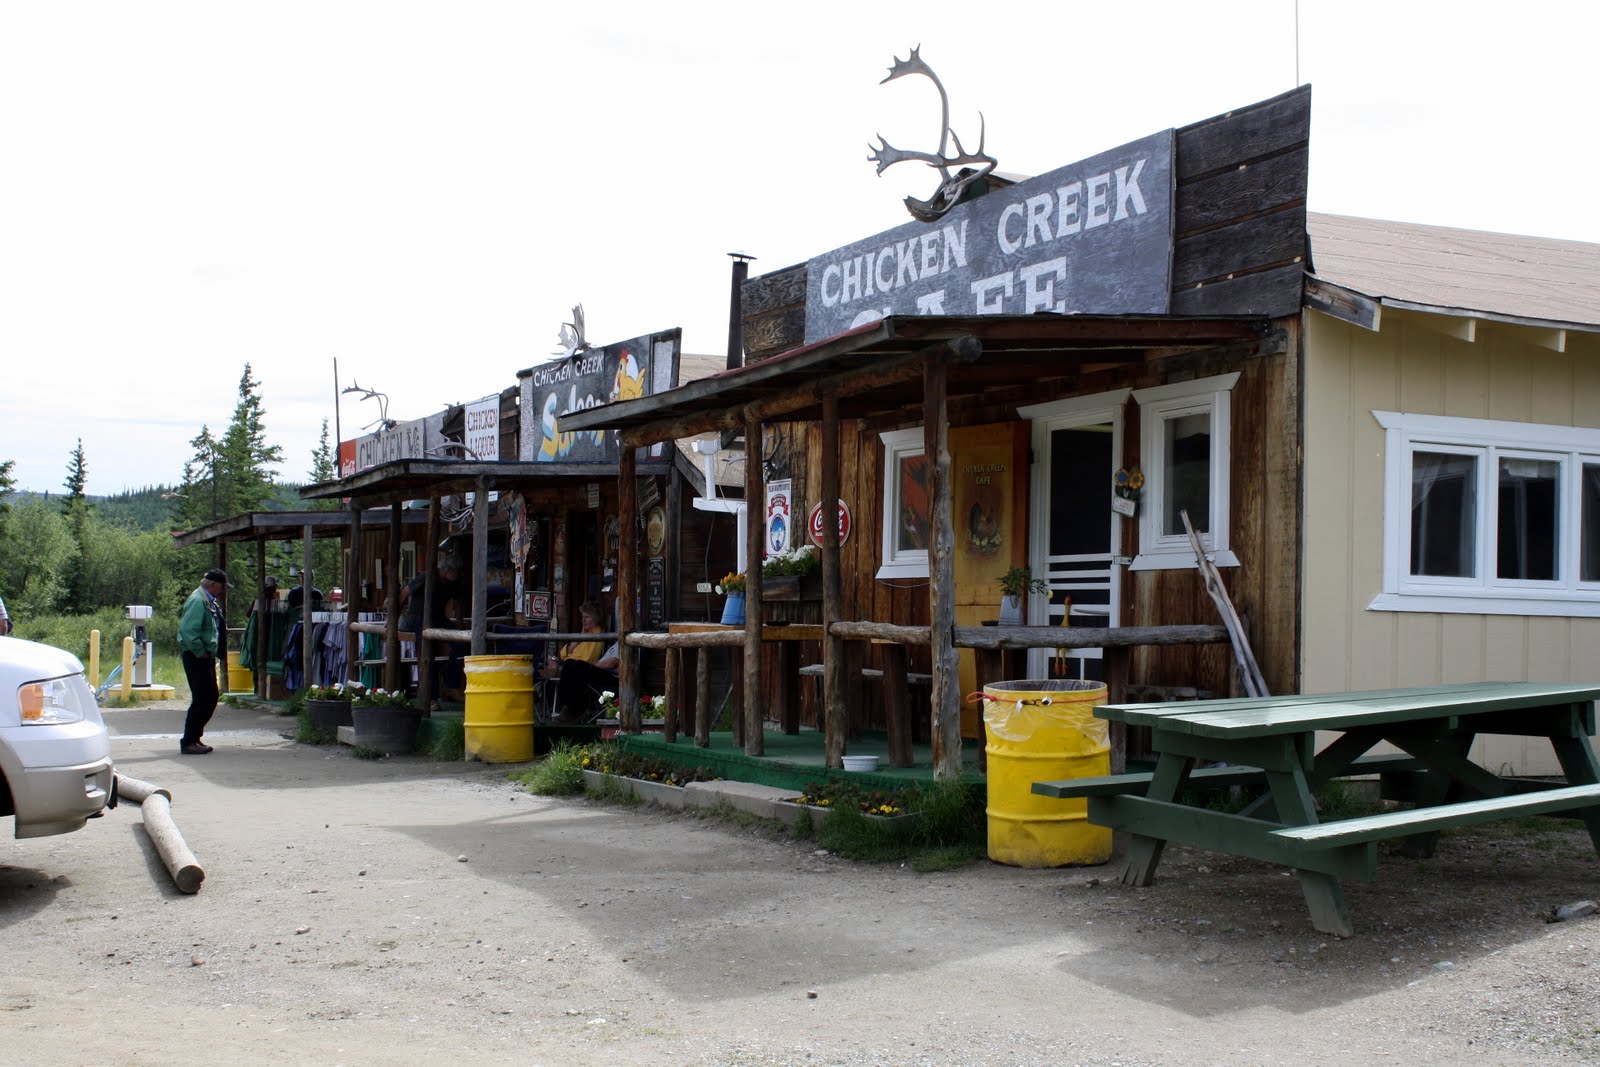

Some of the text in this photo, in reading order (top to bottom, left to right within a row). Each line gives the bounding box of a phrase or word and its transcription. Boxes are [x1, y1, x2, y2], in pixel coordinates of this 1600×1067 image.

[820, 158, 1149, 308] CHICKEN CREEK
[849, 256, 1067, 330] FE
[533, 354, 604, 387] CHICKEN CREEK
[467, 408, 498, 432] CHICKEN
[470, 434, 497, 458] LIQUOR
[975, 476, 992, 486] CAFE
